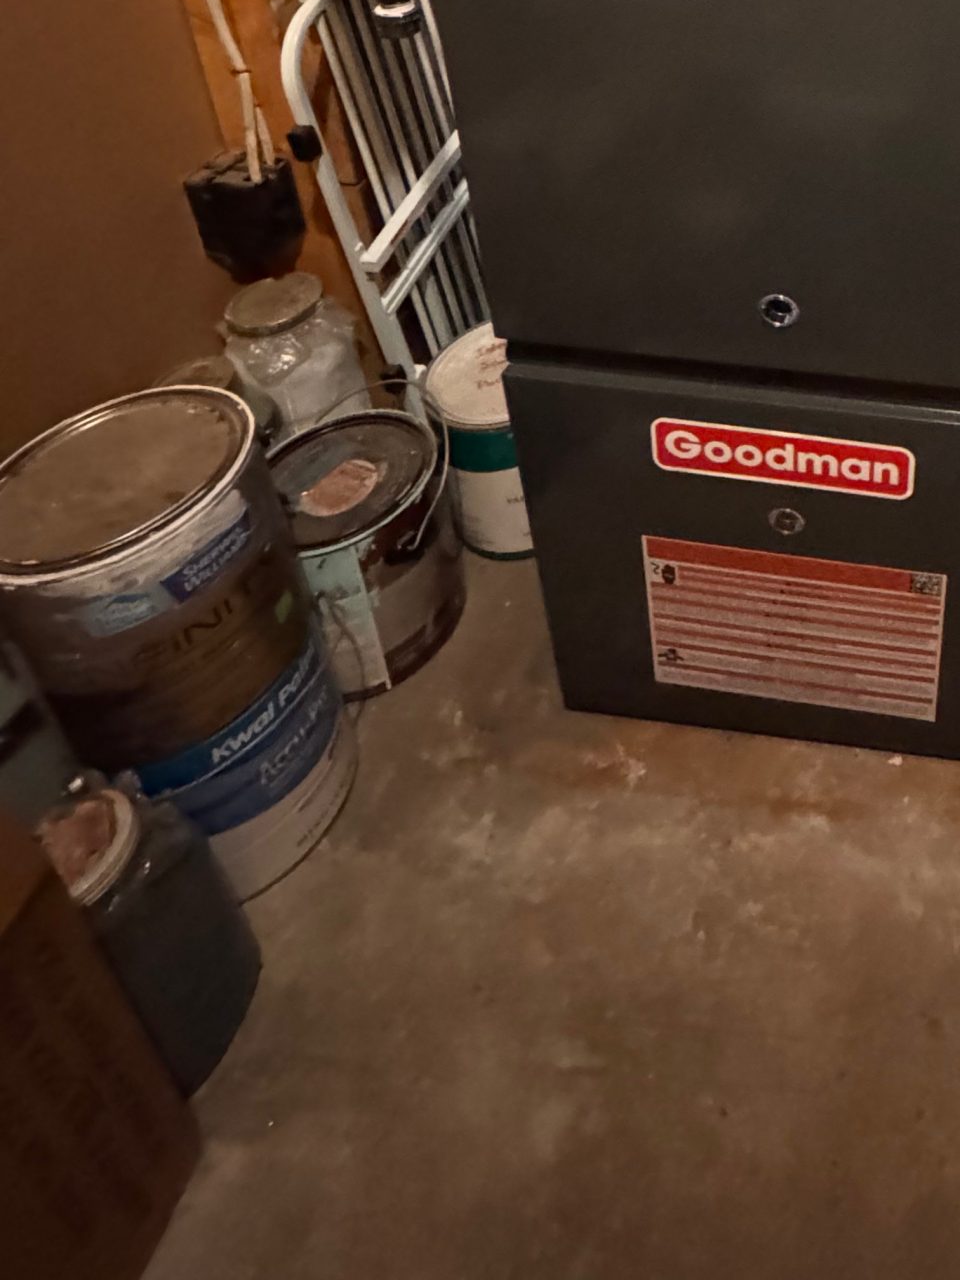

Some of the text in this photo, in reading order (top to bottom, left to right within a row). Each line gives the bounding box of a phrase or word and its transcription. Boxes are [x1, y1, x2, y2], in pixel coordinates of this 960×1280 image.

[663, 429, 901, 487] Goodman
[211, 702, 276, 765] Kwal
[277, 644, 316, 708] Pain
